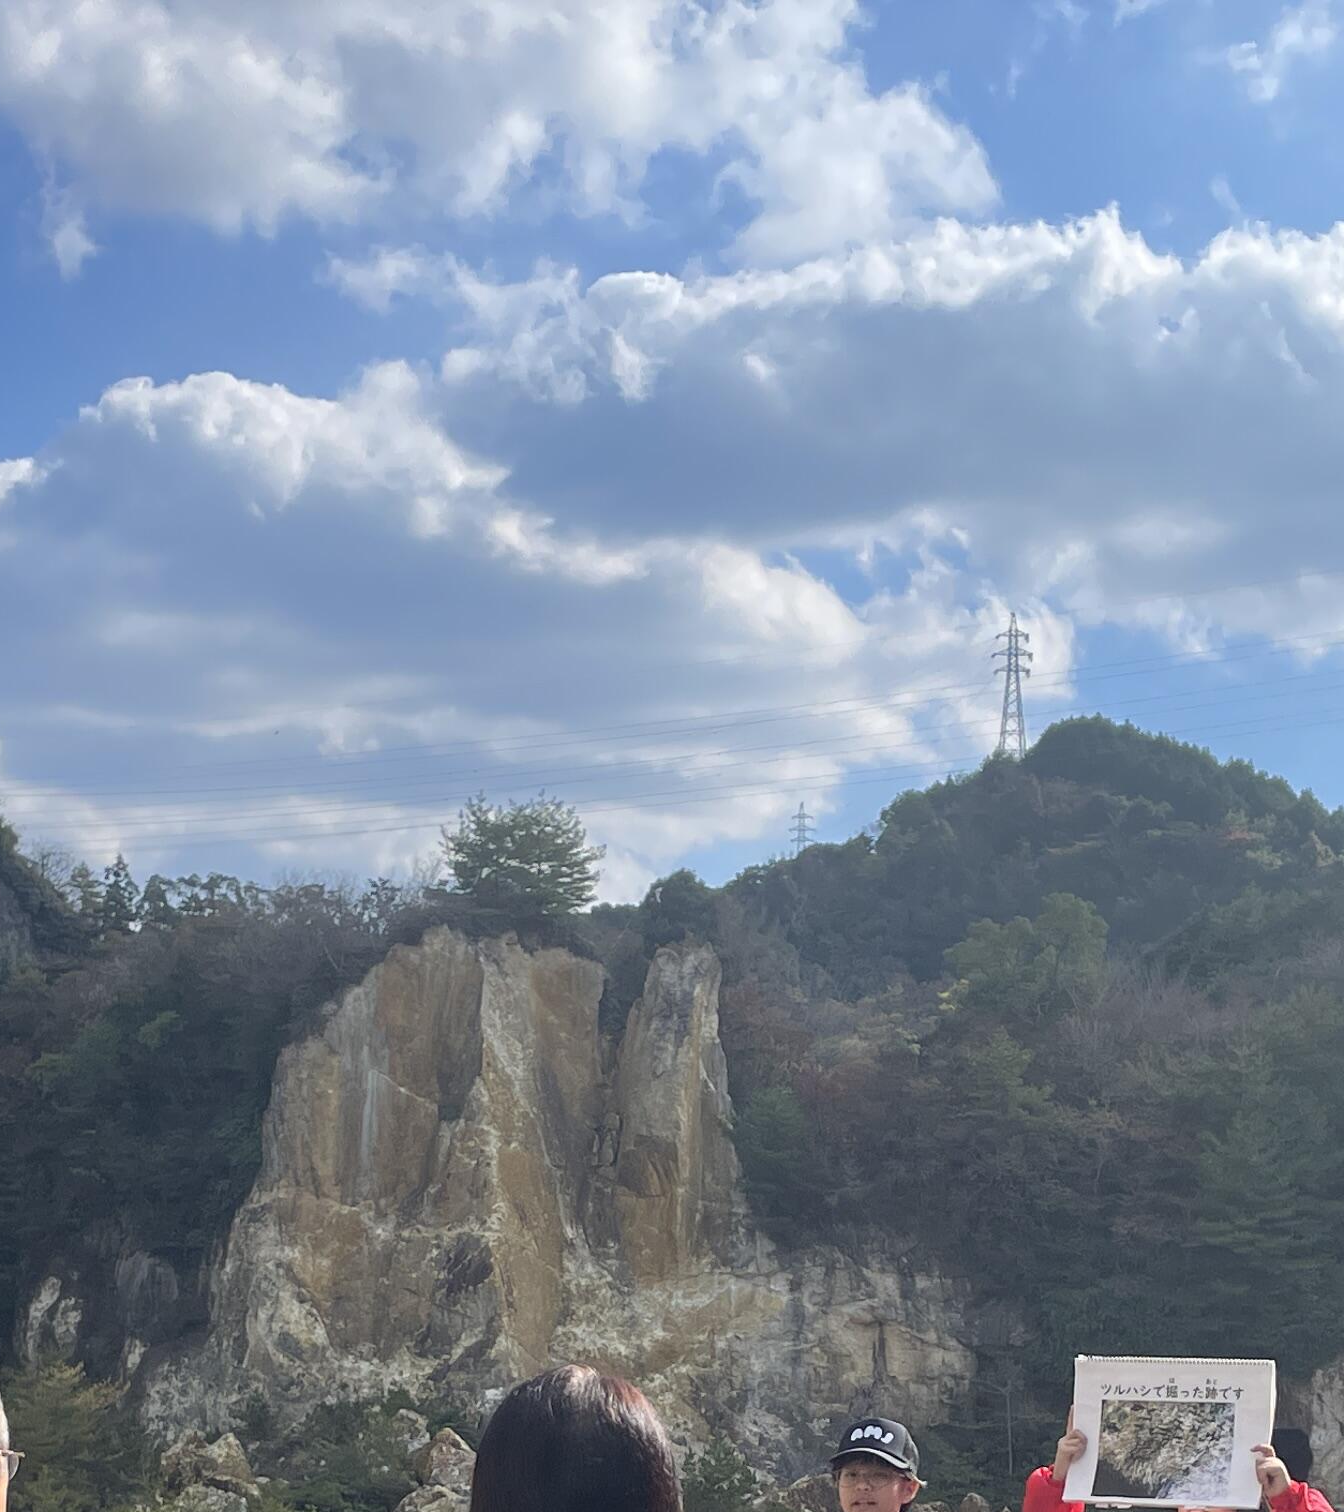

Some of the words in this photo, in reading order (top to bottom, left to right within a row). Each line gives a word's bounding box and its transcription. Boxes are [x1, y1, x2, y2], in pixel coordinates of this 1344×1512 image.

[1100, 1383, 1244, 1400] ツルハシで掘った跡です
